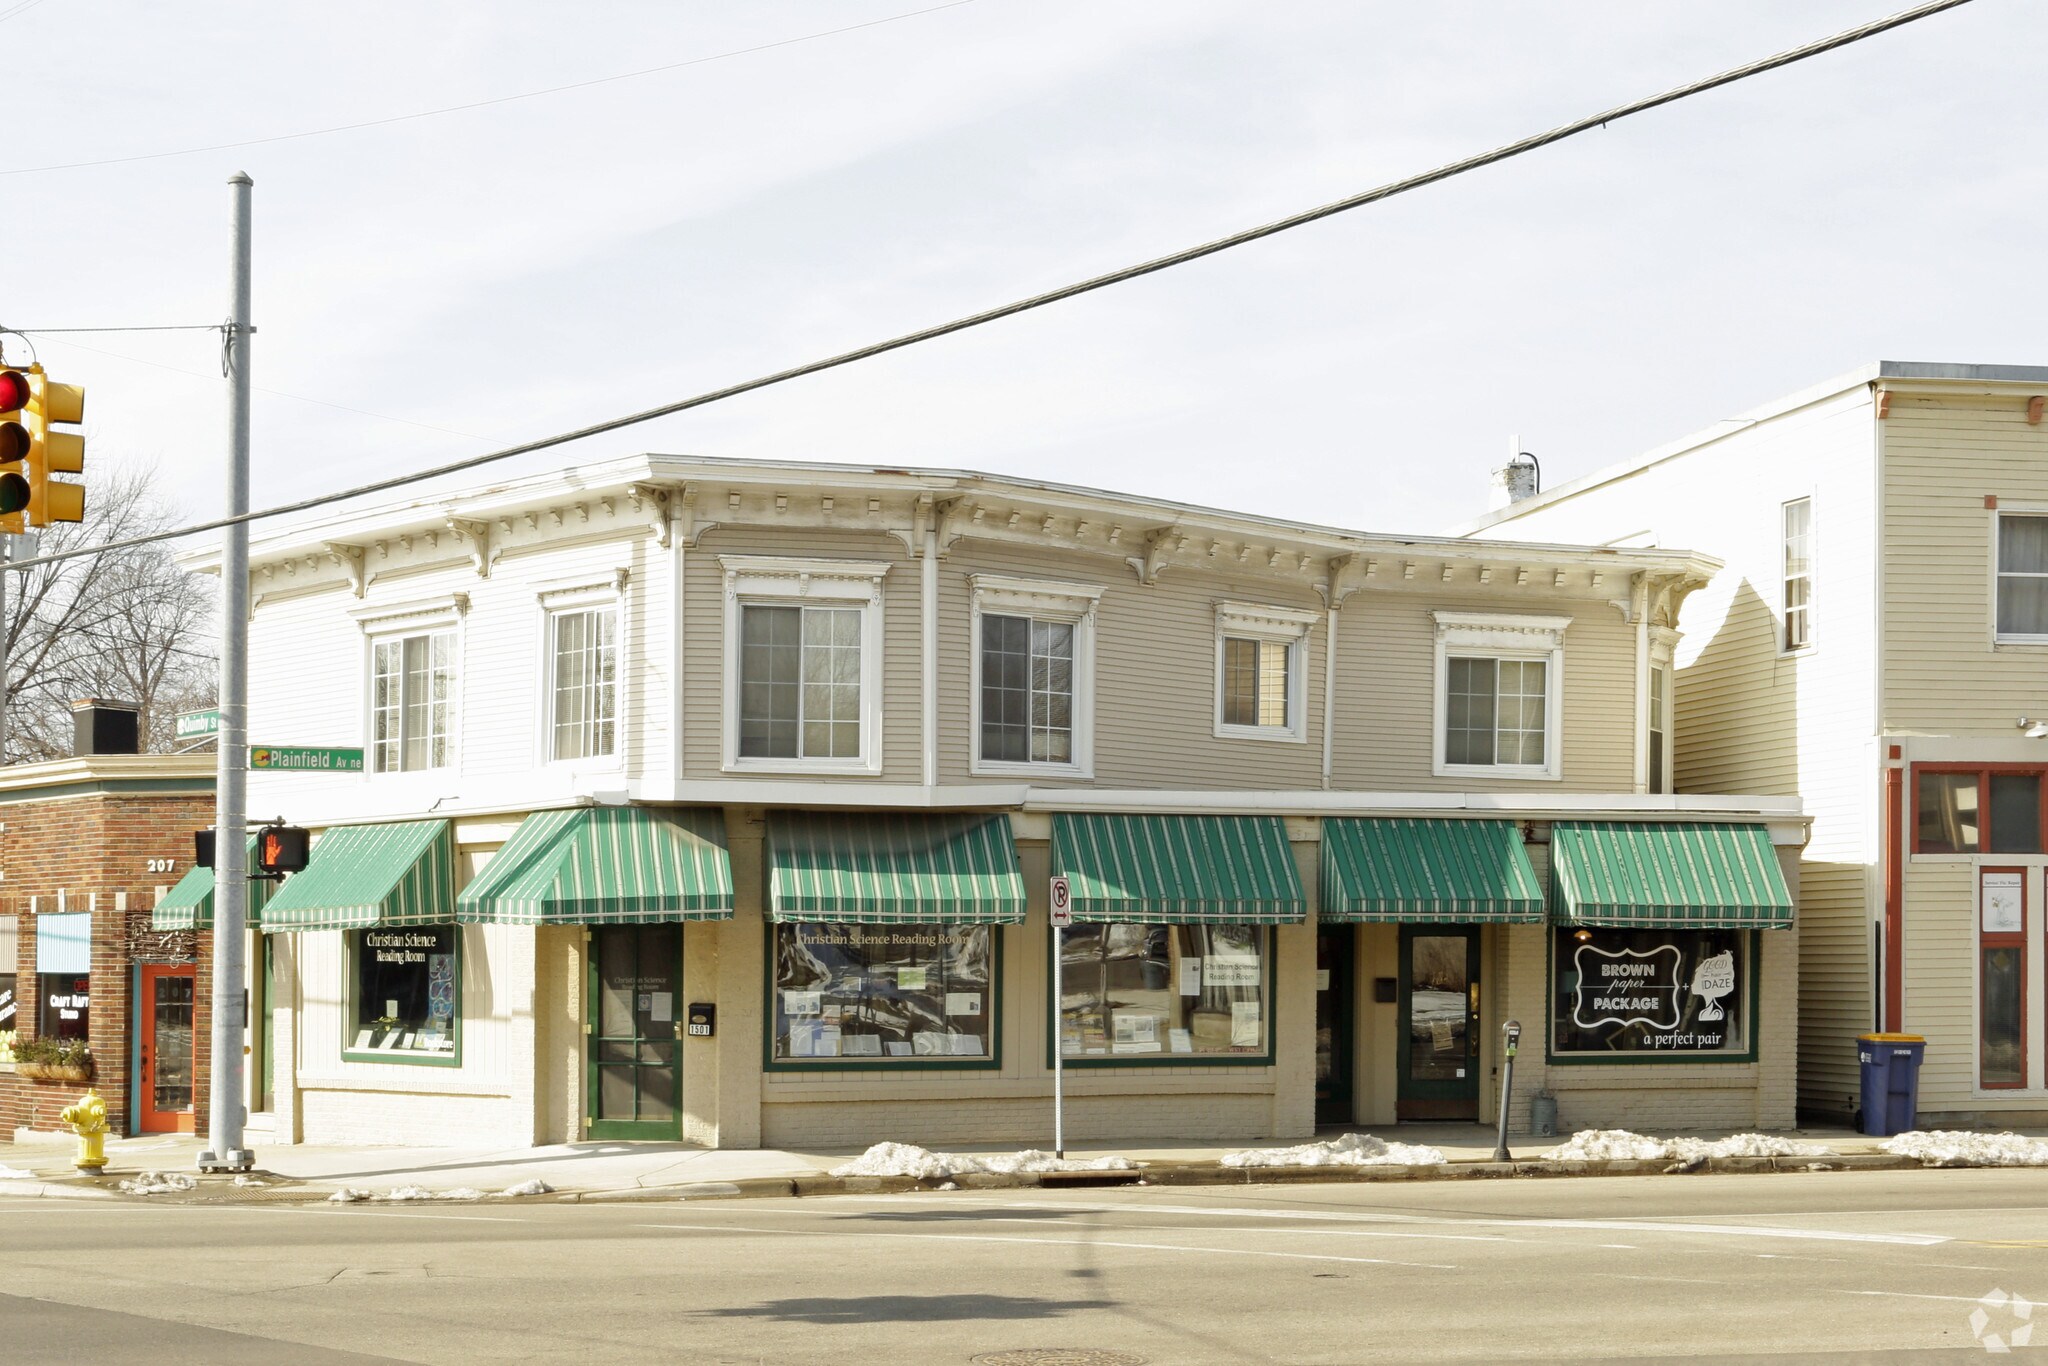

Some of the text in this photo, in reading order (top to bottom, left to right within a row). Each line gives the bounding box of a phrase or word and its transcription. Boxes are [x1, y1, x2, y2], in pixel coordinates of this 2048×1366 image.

[184, 715, 208, 732] Quimby
[271, 750, 362, 768] Plainfield Av ne
[147, 859, 175, 872] 207
[367, 932, 437, 947] Christian Science
[797, 933, 970, 947] Christian Science Reading Room
[376, 949, 426, 965] Reading Room
[1209, 973, 1235, 981] Reading
[1601, 963, 1655, 977] BROWN
[614, 976, 643, 984] Christin
[1607, 979, 1645, 994] paper
[1704, 978, 1731, 989] DAZE
[1594, 997, 1659, 1010] PACKAGE
[690, 1025, 710, 1035] 1501
[1643, 1029, 1722, 1049] a perfect pair
